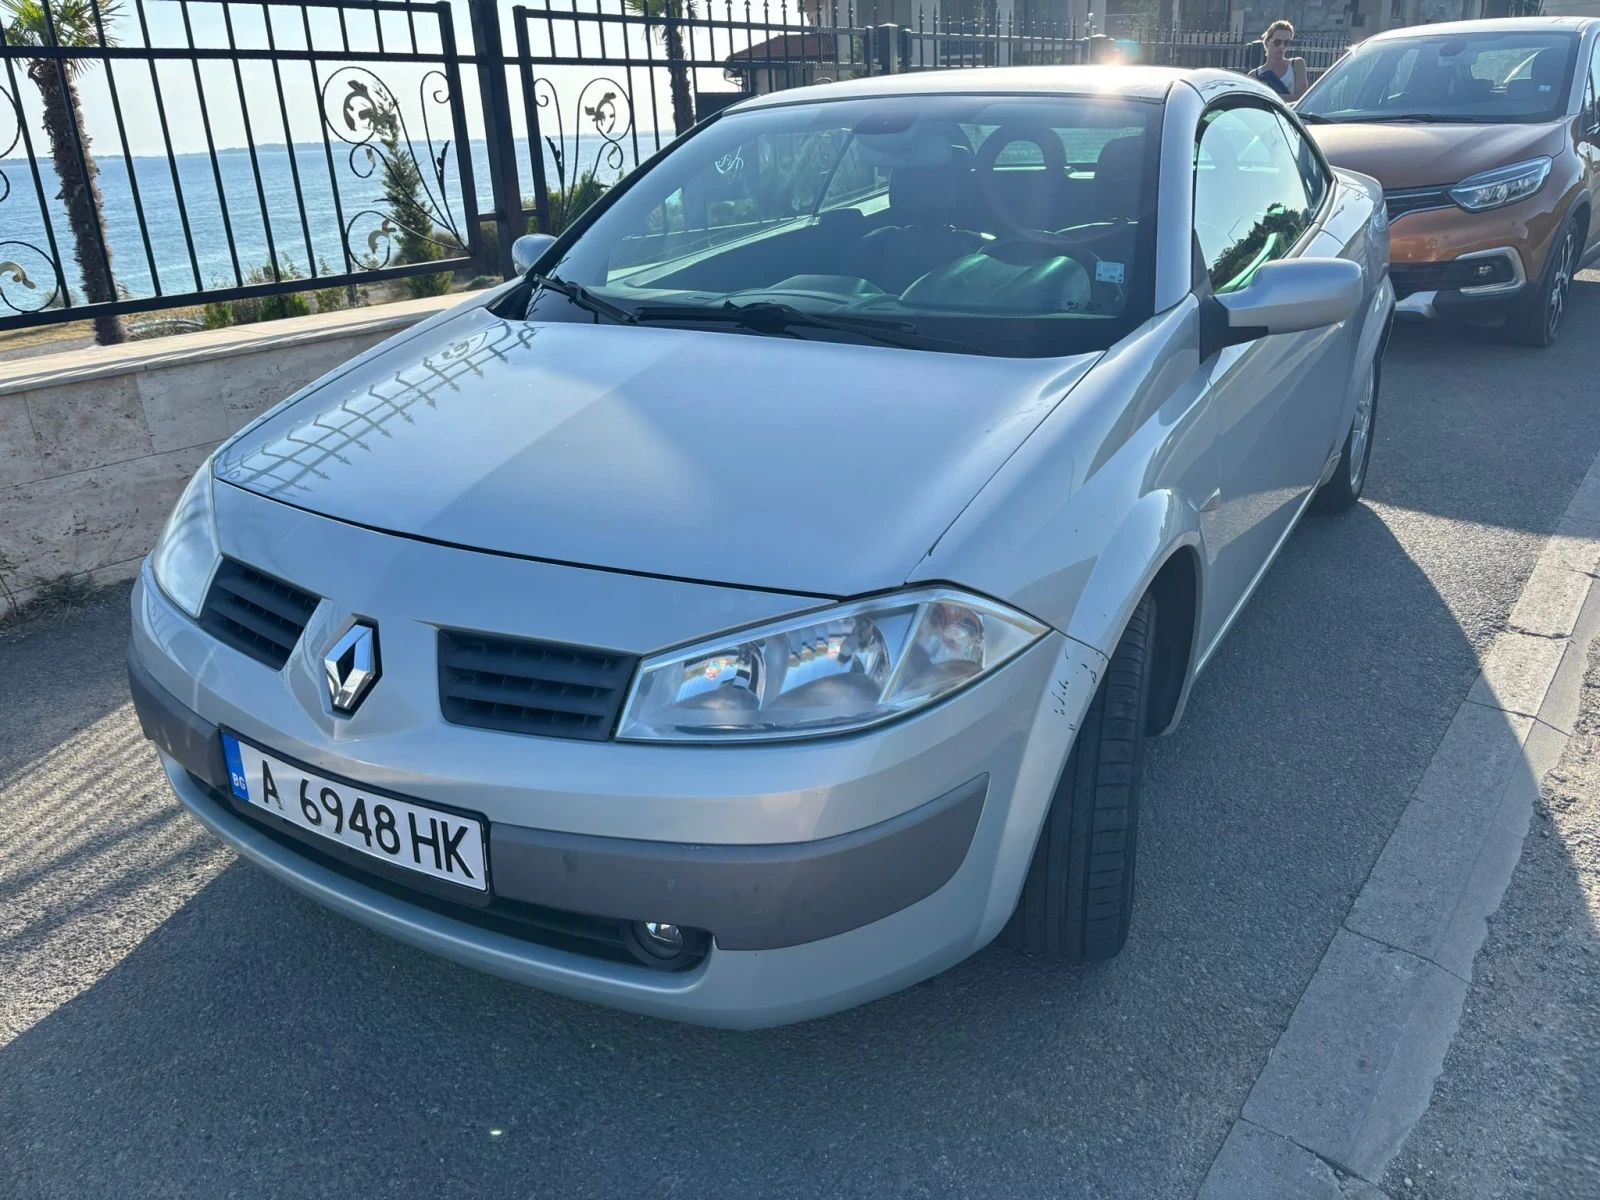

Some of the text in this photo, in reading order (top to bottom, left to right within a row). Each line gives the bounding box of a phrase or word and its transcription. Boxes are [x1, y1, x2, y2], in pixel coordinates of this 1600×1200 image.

[232, 772, 246, 790] BG
[262, 760, 475, 879] A 6948 HK
